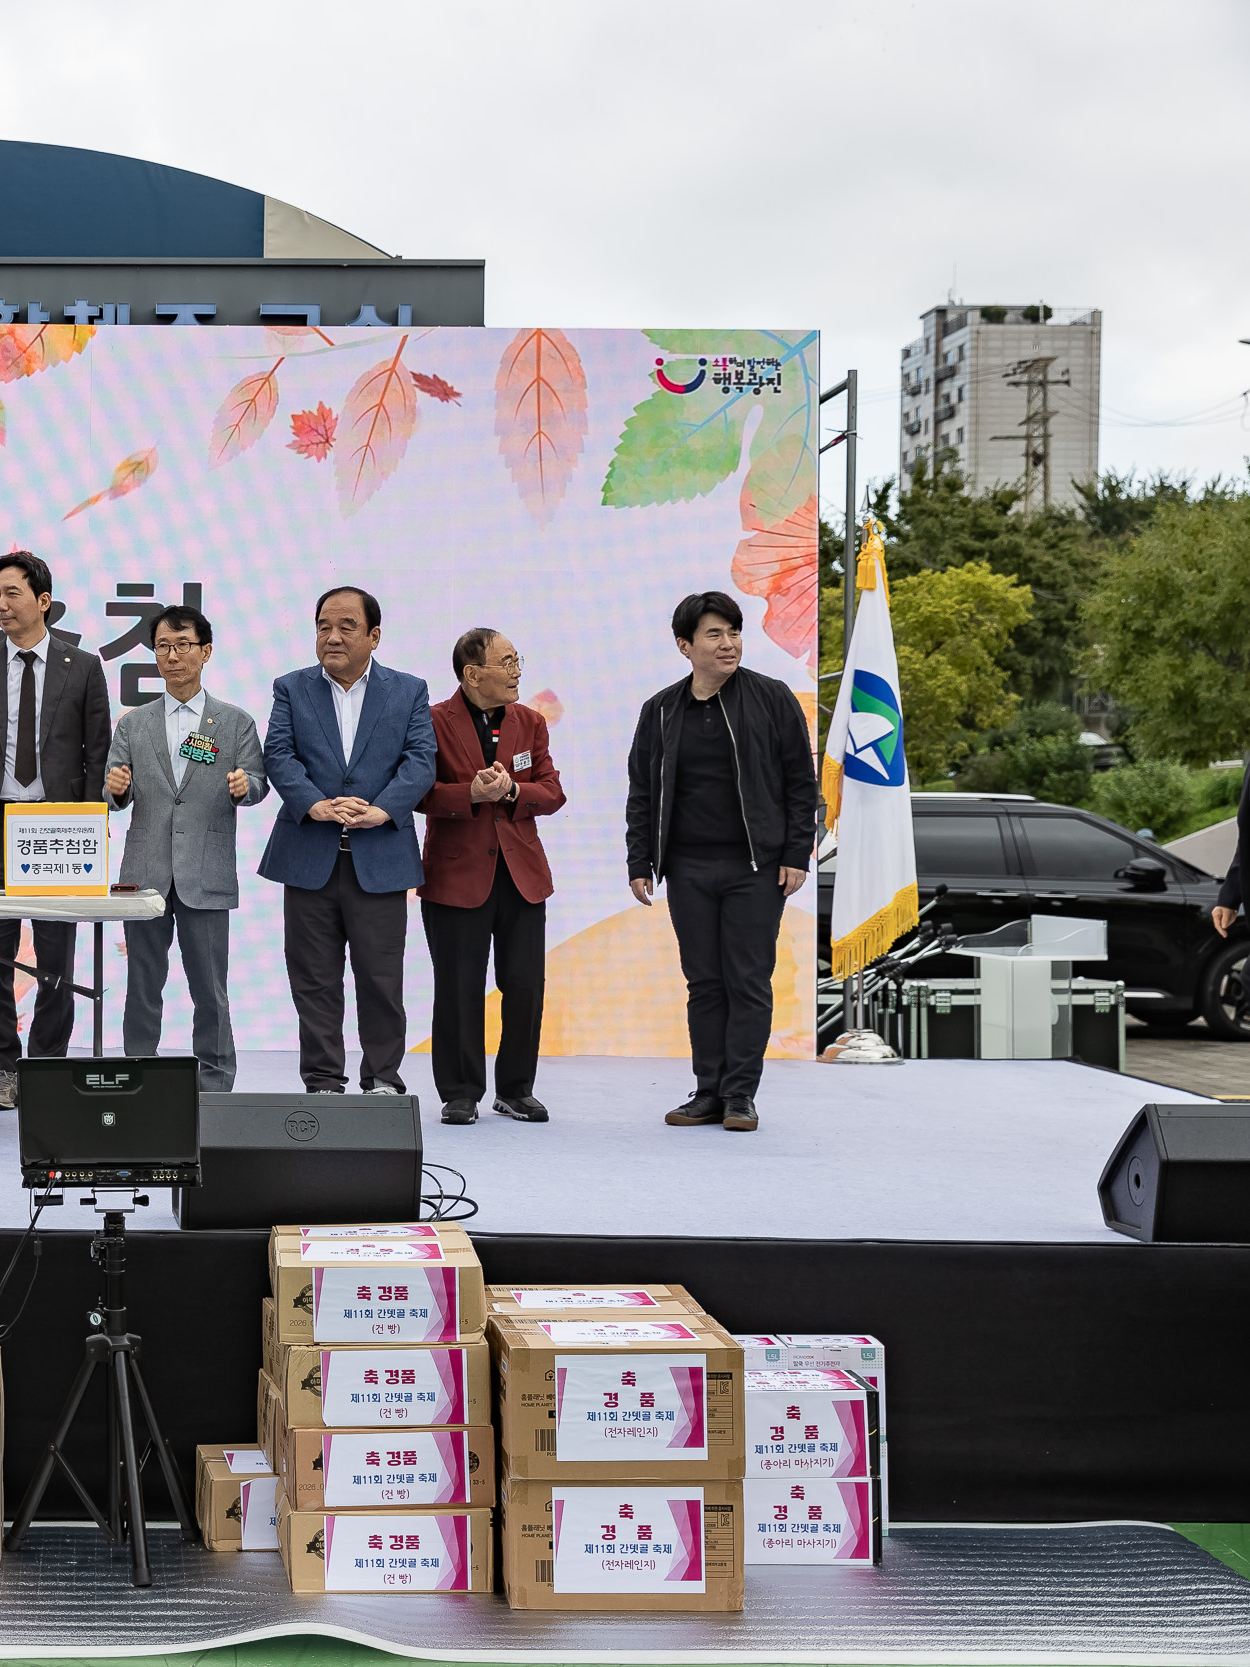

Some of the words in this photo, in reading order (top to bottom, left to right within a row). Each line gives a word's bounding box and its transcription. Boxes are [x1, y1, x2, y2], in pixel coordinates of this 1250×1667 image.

[712, 357, 745, 371] 소통하며
[712, 371, 781, 395] 행복광진
[180, 744, 216, 764] 전병주
[17, 839, 98, 855] 경품추첨함
[31, 863, 82, 874] 중곡제1동
[86, 1074, 130, 1085] ELF
[288, 1120, 316, 1133] RCF
[356, 1285, 371, 1300] 축
[377, 1285, 409, 1300] 경품
[343, 1309, 373, 1319] 제11회
[377, 1308, 405, 1319] 간뎃골
[409, 1308, 428, 1318] 축제
[364, 1369, 379, 1385] 축
[385, 1369, 416, 1385] 경품
[621, 1371, 636, 1387] 축
[350, 1393, 380, 1403] 제11회
[384, 1392, 413, 1403] 간뎃골
[417, 1392, 436, 1402] 축제
[603, 1392, 619, 1408] 경
[639, 1392, 655, 1408] 품
[587, 1411, 618, 1422] 제11회
[655, 1411, 675, 1421] 축제
[786, 1405, 801, 1420] 축
[604, 1427, 658, 1438] (전자레인지)
[769, 1426, 785, 1441] 경
[804, 1425, 819, 1440] 품
[754, 1444, 784, 1454] 제11회
[819, 1442, 838, 1452] 축제
[365, 1451, 381, 1466] 축
[386, 1450, 418, 1466] 경품
[760, 1459, 791, 1470] (종아리
[794, 1458, 834, 1469] 마사지기)
[352, 1474, 383, 1485] 제11회
[386, 1473, 415, 1484] 간뎃골
[418, 1473, 437, 1483] 축제
[790, 1485, 805, 1500] 축
[618, 1504, 635, 1520] 축
[773, 1505, 788, 1520] 경
[808, 1505, 822, 1520] 품
[521, 1524, 546, 1532] 홈플래닛
[601, 1525, 616, 1540] 경
[637, 1525, 652, 1540] 품
[757, 1523, 787, 1533] 제11회
[822, 1523, 841, 1533] 축제
[368, 1535, 383, 1550] 축
[389, 1535, 421, 1550] 경품
[584, 1544, 615, 1554] 제11회
[652, 1544, 672, 1554] 축제
[762, 1538, 794, 1549] (종아리
[797, 1538, 837, 1549] 마사지기)
[354, 1558, 385, 1568] 제11회
[388, 1558, 417, 1568] 간뎃골
[421, 1558, 439, 1568] 축제
[601, 1559, 656, 1570] (전자레인지)
